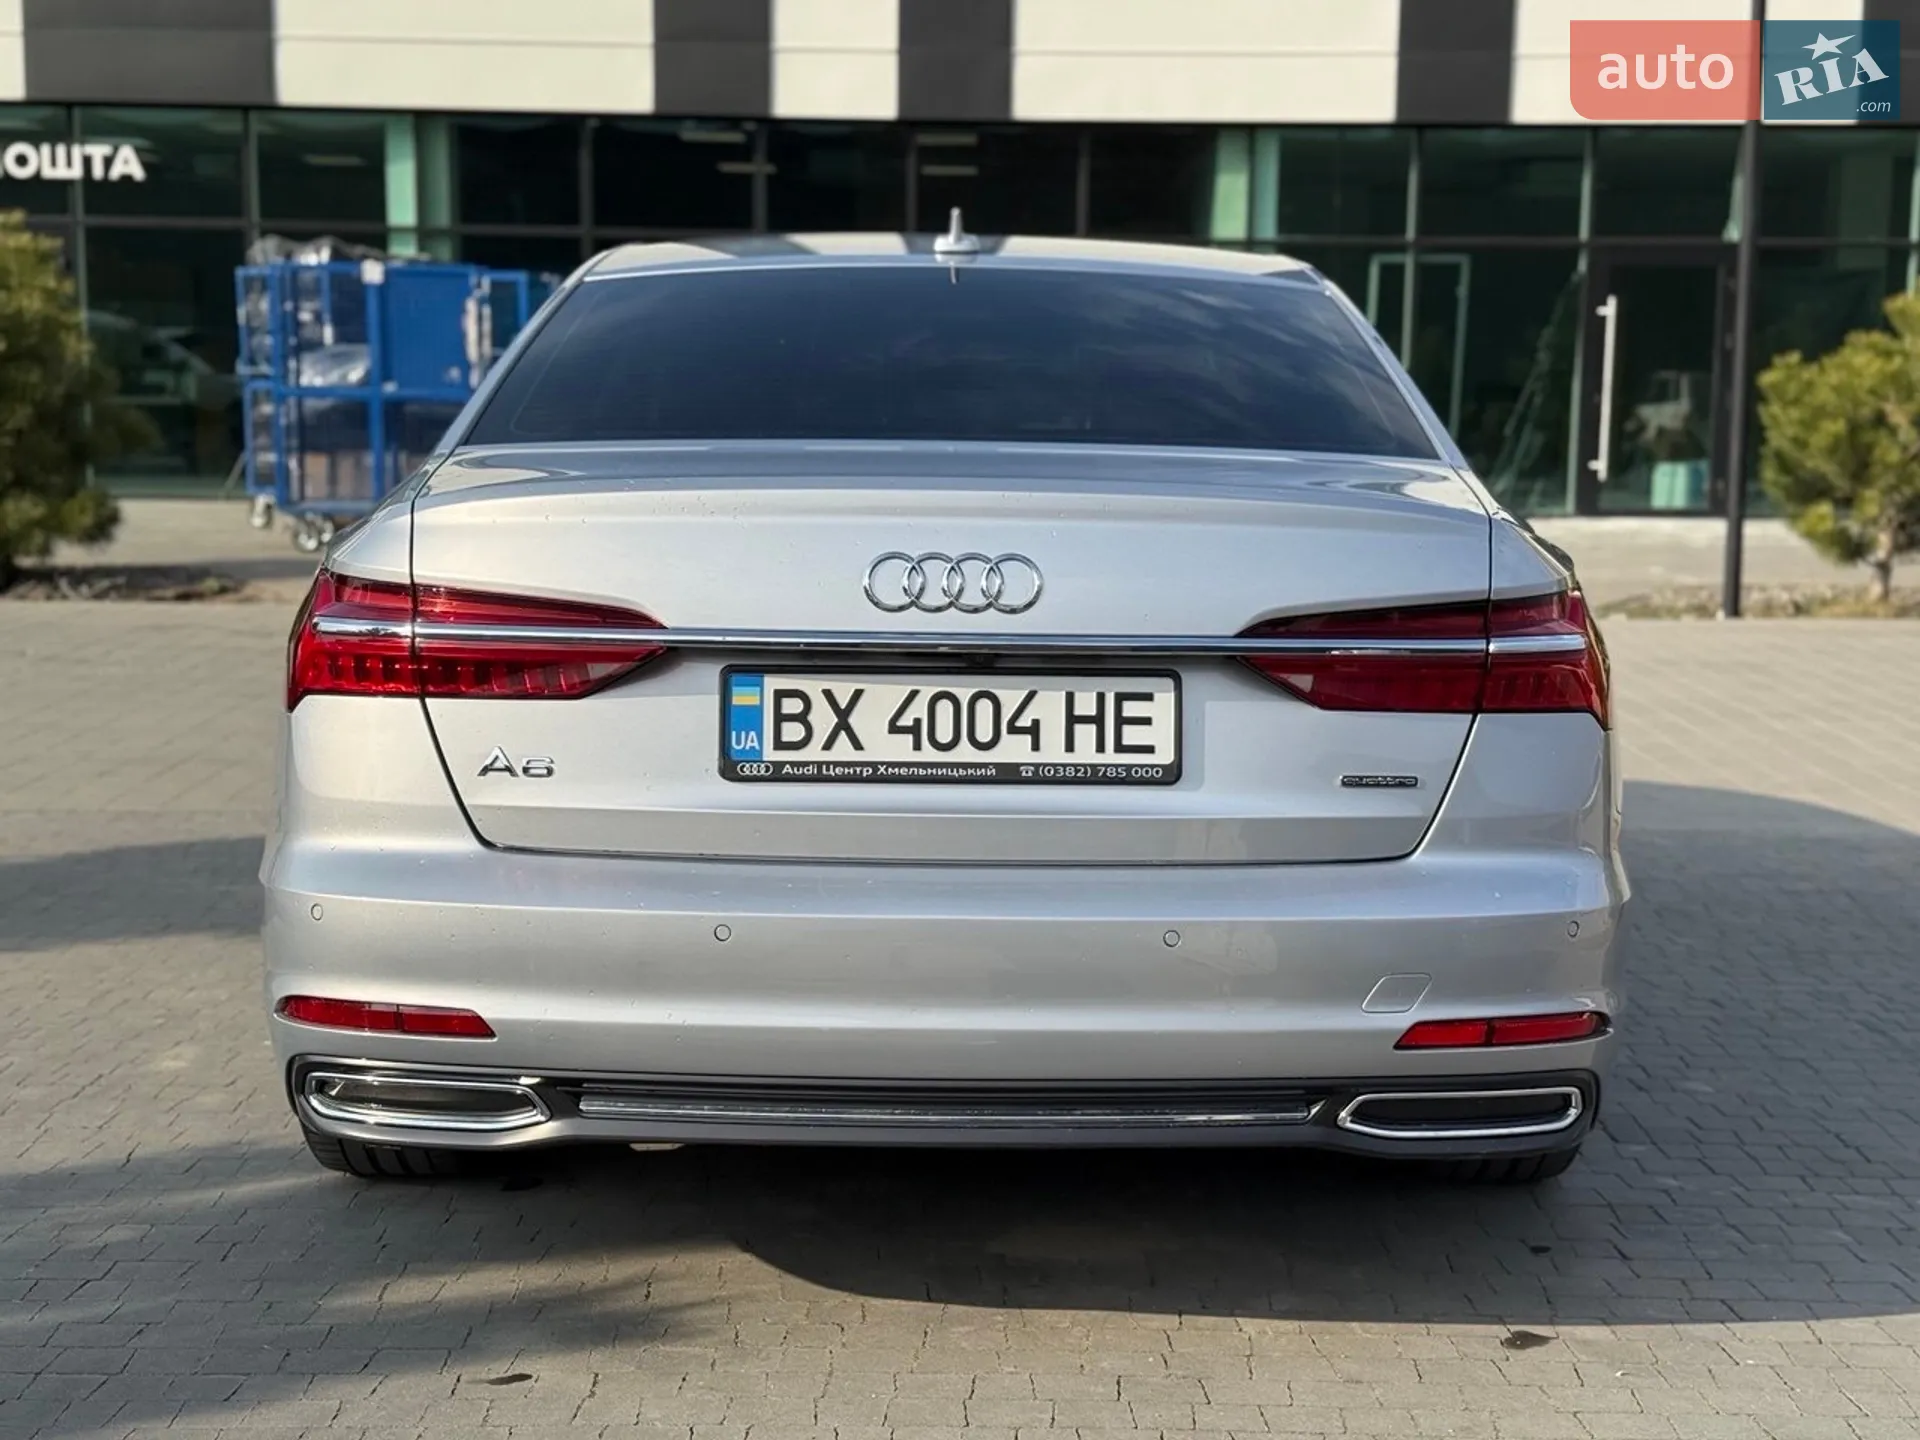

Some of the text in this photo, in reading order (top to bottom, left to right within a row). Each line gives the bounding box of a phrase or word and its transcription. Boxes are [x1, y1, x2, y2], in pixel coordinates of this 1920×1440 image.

[0, 140, 147, 182] ОШТА
[771, 687, 1157, 754] BX 4004 HE
[731, 729, 760, 750] UA
[476, 744, 556, 778] A6
[781, 763, 997, 778] Audi Центр Хмельницький
[1038, 765, 1163, 779] (0382) 785 000
[1343, 776, 1417, 786] quattro
